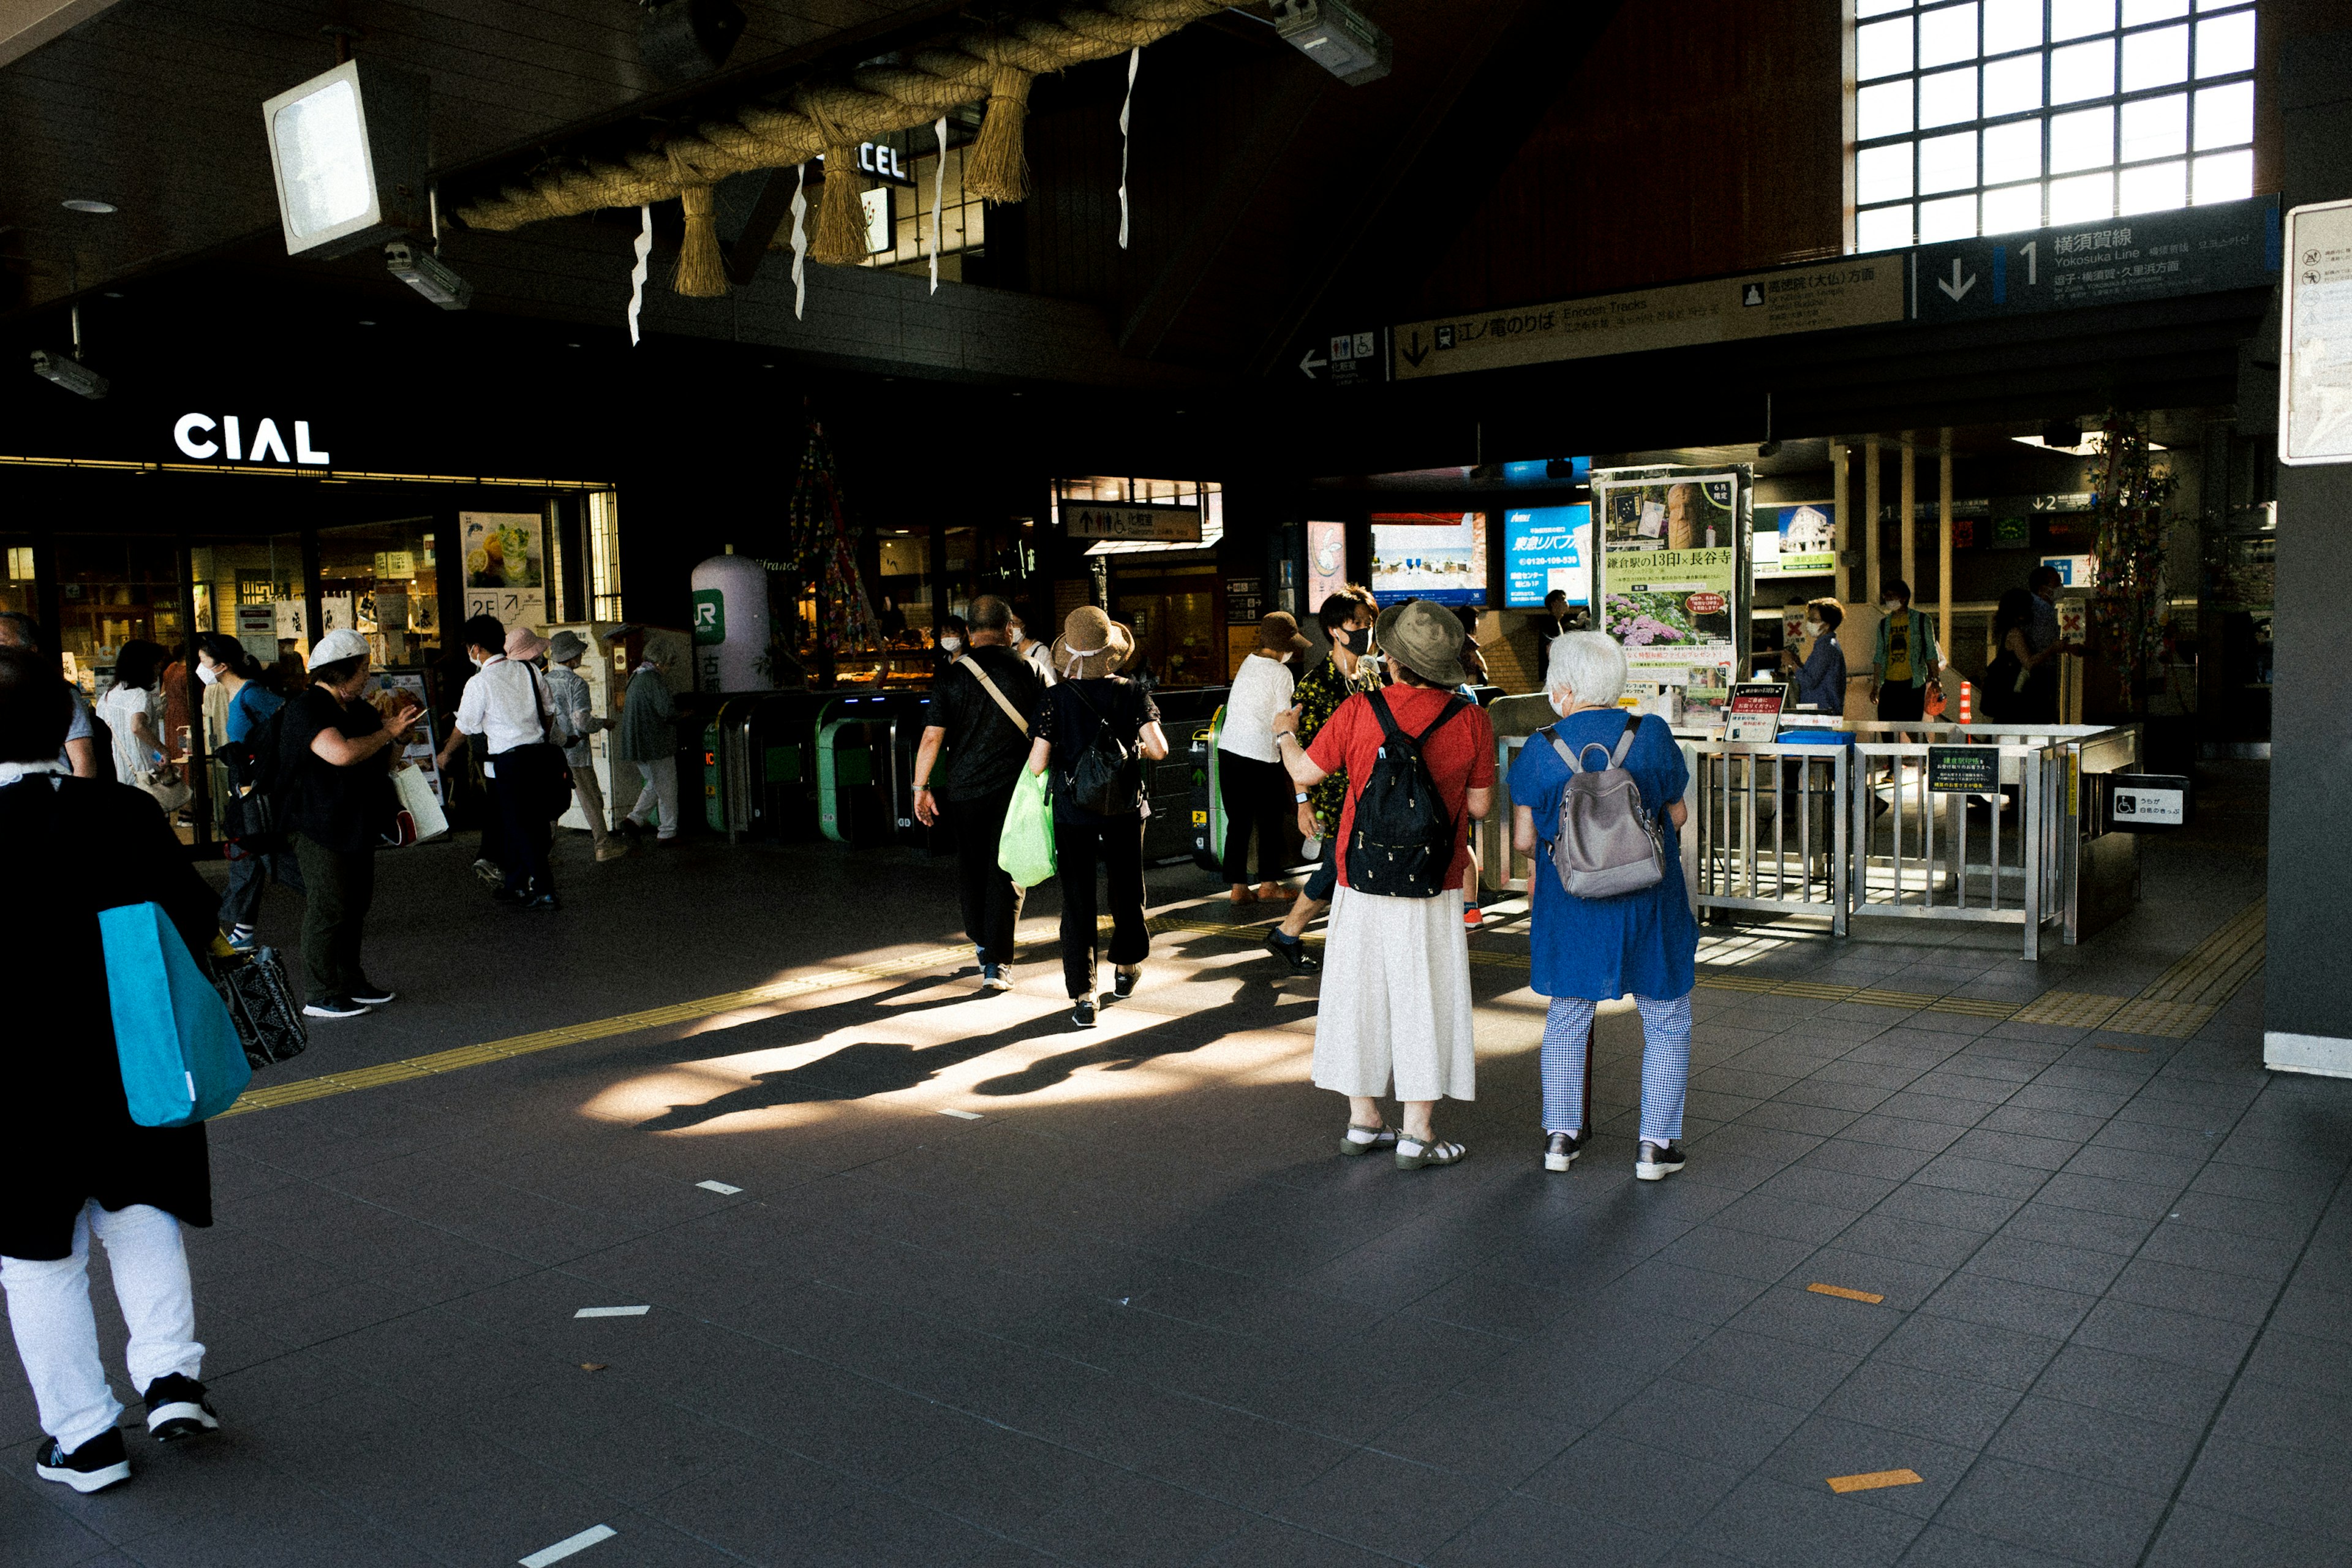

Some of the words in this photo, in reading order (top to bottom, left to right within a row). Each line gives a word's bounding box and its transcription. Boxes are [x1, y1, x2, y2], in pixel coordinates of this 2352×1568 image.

[855, 141, 905, 178] CEL
[2054, 227, 2132, 255] 横須賀線
[2019, 241, 2037, 285] 1
[2055, 249, 2111, 268] Yokosuka
[2115, 247, 2140, 260] Line
[1610, 299, 1648, 313] Tracks
[1458, 309, 1555, 342] 江ノ電のりば
[174, 413, 330, 464] CIAL
[2046, 496, 2056, 510] 2
[473, 600, 494, 617] 2F
[694, 602, 716, 626] JR
[1890, 625, 1909, 634] FIAT
[705, 751, 715, 766] IC
